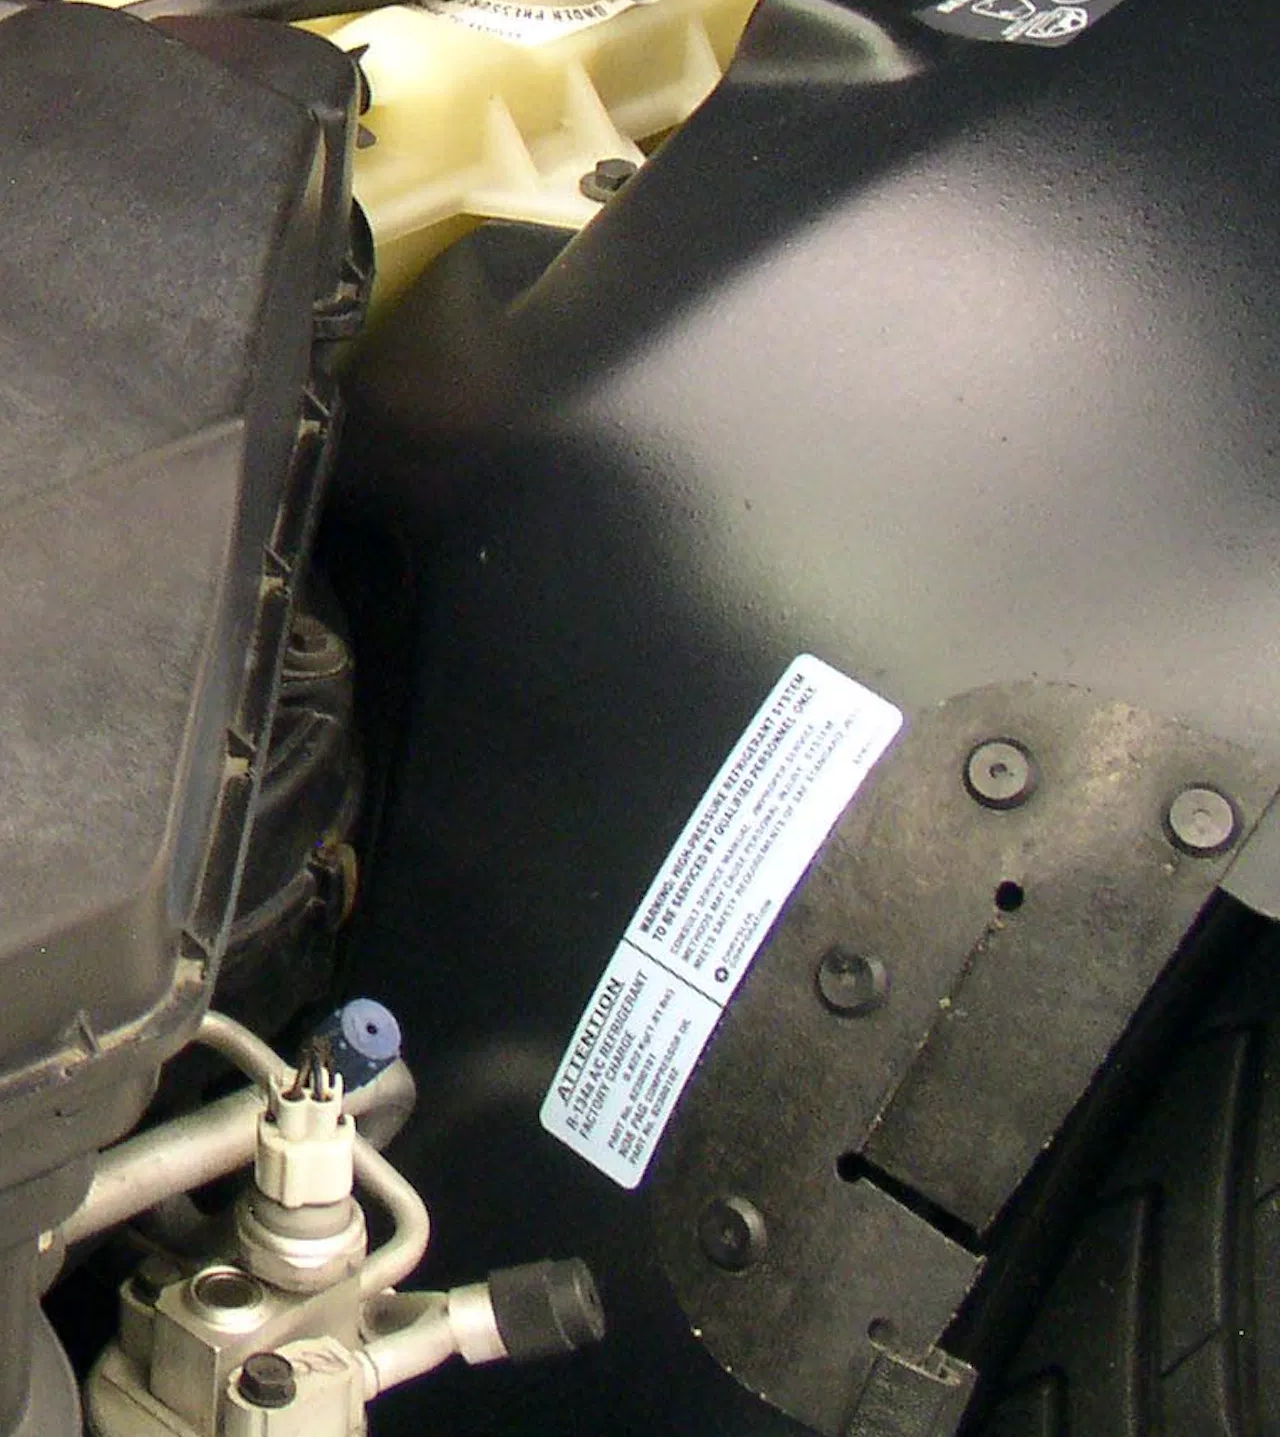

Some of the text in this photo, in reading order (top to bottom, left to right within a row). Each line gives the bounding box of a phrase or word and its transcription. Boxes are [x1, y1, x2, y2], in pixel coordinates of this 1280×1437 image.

[653, 684, 816, 942] TO BE SERVICED BY QUALIFIED PERSONNEL ONLY
[671, 791, 726, 876] HIGH-PRESSURE
[723, 718, 774, 790] REFRIGERANT
[772, 673, 804, 715] SYSTEM
[556, 978, 622, 1100] ATTENTION
[566, 1081, 594, 1128] R-134a
[598, 970, 648, 1056] REFRIGERANT
[577, 1030, 635, 1138] FACTORY CHARGE
[643, 1034, 680, 1102] COMPRESSOR
[606, 1121, 623, 1148] PART
